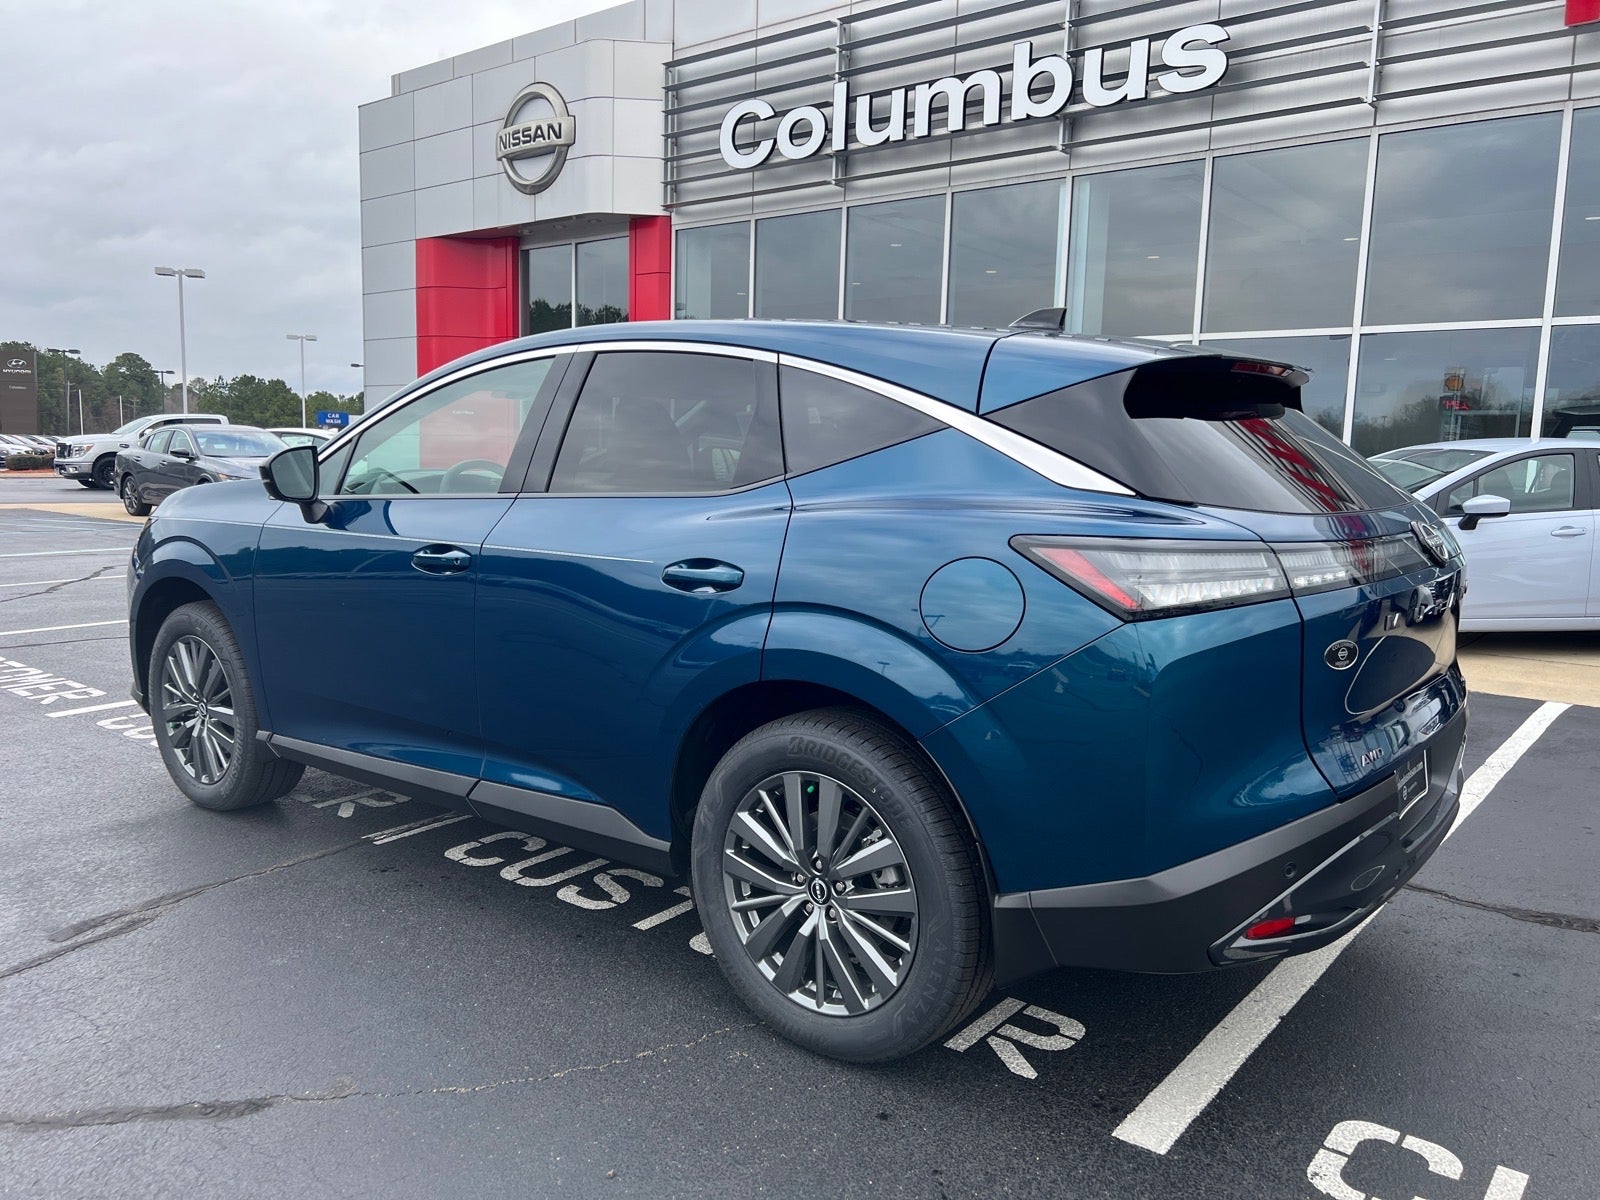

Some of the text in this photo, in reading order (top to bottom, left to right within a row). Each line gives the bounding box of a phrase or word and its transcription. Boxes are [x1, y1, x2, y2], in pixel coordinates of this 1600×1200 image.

[719, 24, 1230, 169] Columbus
[499, 122, 562, 151] NISSAN
[787, 736, 915, 831] BRIDGESTONE
[1361, 748, 1384, 767] AWD
